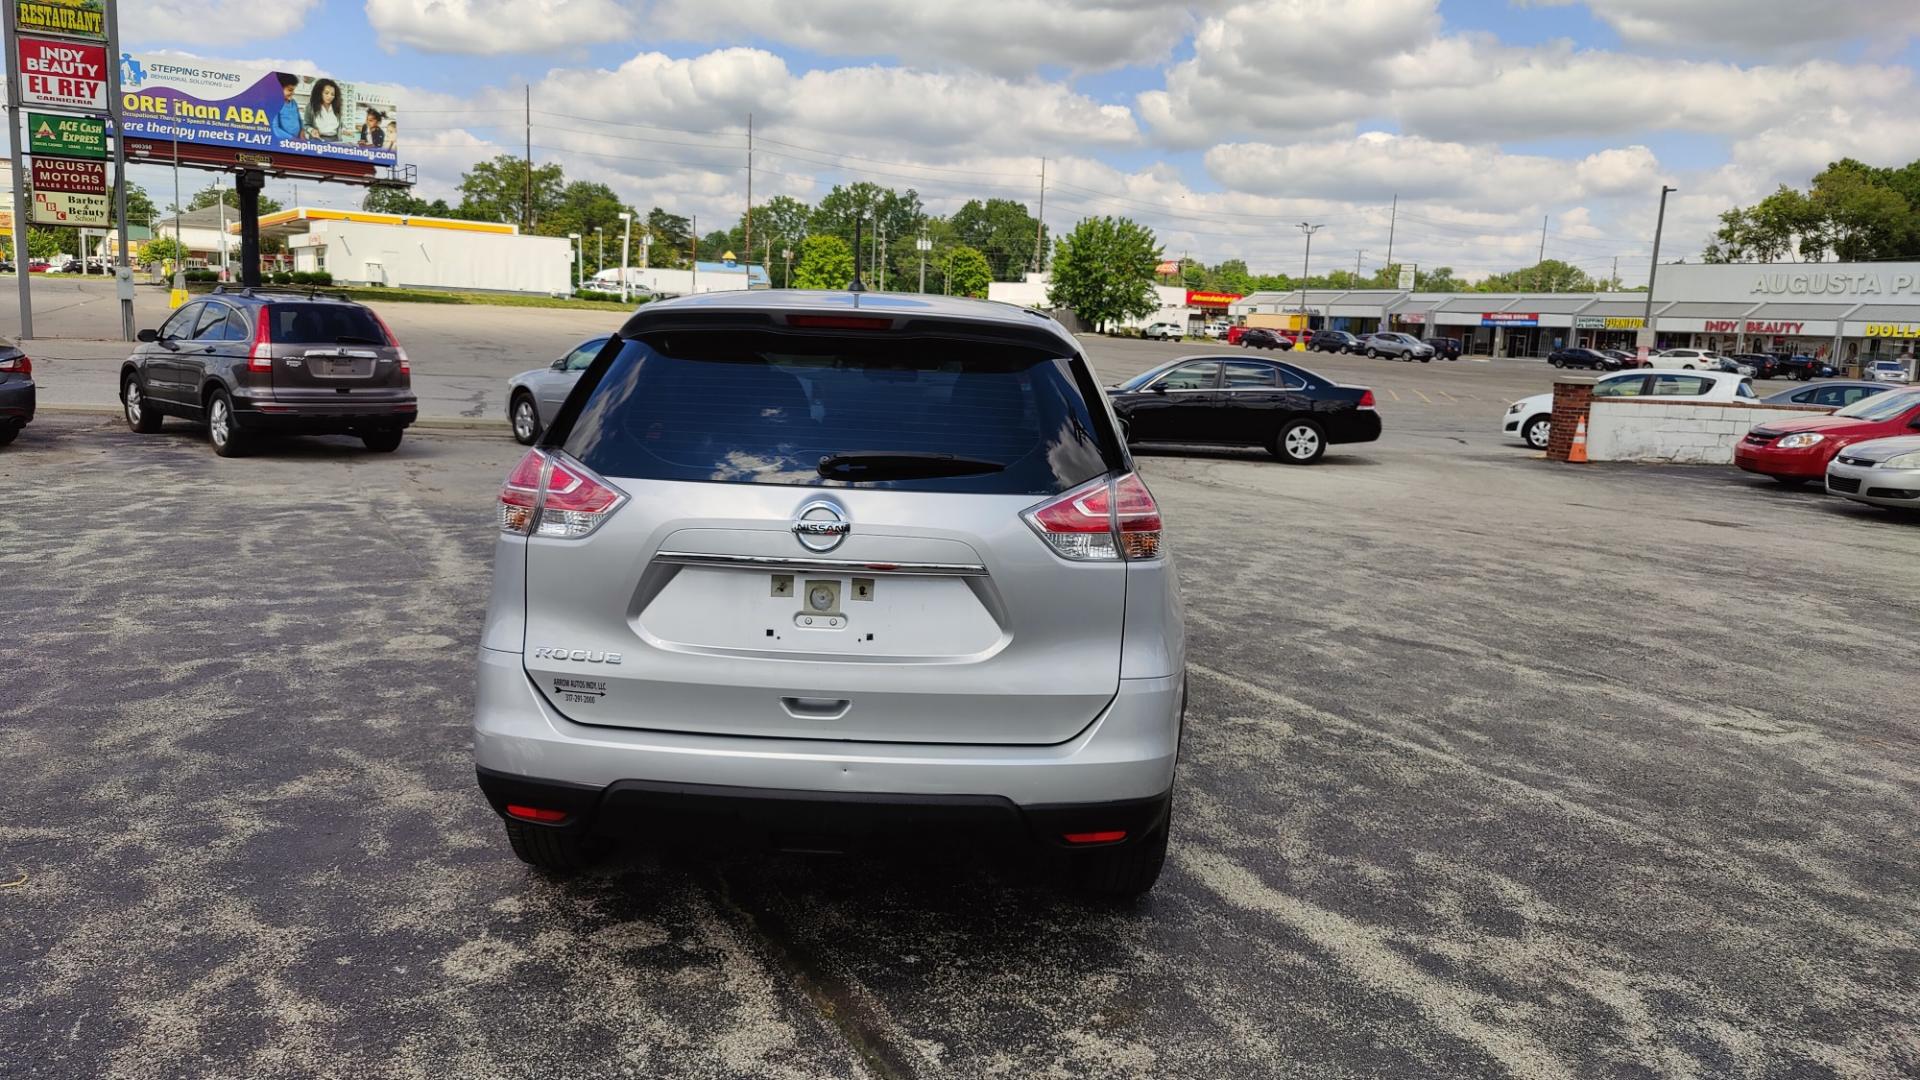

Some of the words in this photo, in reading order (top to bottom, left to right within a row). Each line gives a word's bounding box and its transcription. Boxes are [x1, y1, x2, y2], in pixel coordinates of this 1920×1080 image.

[20, 3, 100, 32] RESTAURANT
[40, 46, 84, 62] INDY
[27, 57, 98, 77] BEAUTY
[150, 63, 199, 78] STEPPING
[201, 70, 240, 82] STONES
[29, 75, 52, 94] EL
[58, 78, 99, 99] REY
[150, 73, 187, 83] BEHAVIORAL
[189, 78, 222, 88] SOLUTIONS
[36, 95, 92, 105] CARNICERIA
[122, 93, 168, 114] ORE
[173, 98, 220, 120] than
[225, 105, 270, 126] ABA
[58, 120, 79, 130] ACE
[147, 122, 196, 139] therapy
[198, 129, 234, 141] meets
[237, 132, 272, 146] PLAY!
[280, 139, 395, 161] steppingstonesindy.com
[35, 160, 103, 173] AUGUSTA
[40, 171, 99, 184] MOTORS
[68, 196, 104, 206] Barber
[68, 207, 104, 217] Beauty
[74, 214, 97, 222] School
[1750, 272, 1882, 294] AUGUSTA
[1704, 320, 1738, 331] INDY
[1746, 321, 1804, 334] BEAUTY
[796, 523, 844, 532] NISSAN
[535, 647, 621, 664] ROGUE
[553, 678, 570, 687] ARROW
[570, 680, 585, 688] AUTOS
[598, 682, 606, 690] LLC
